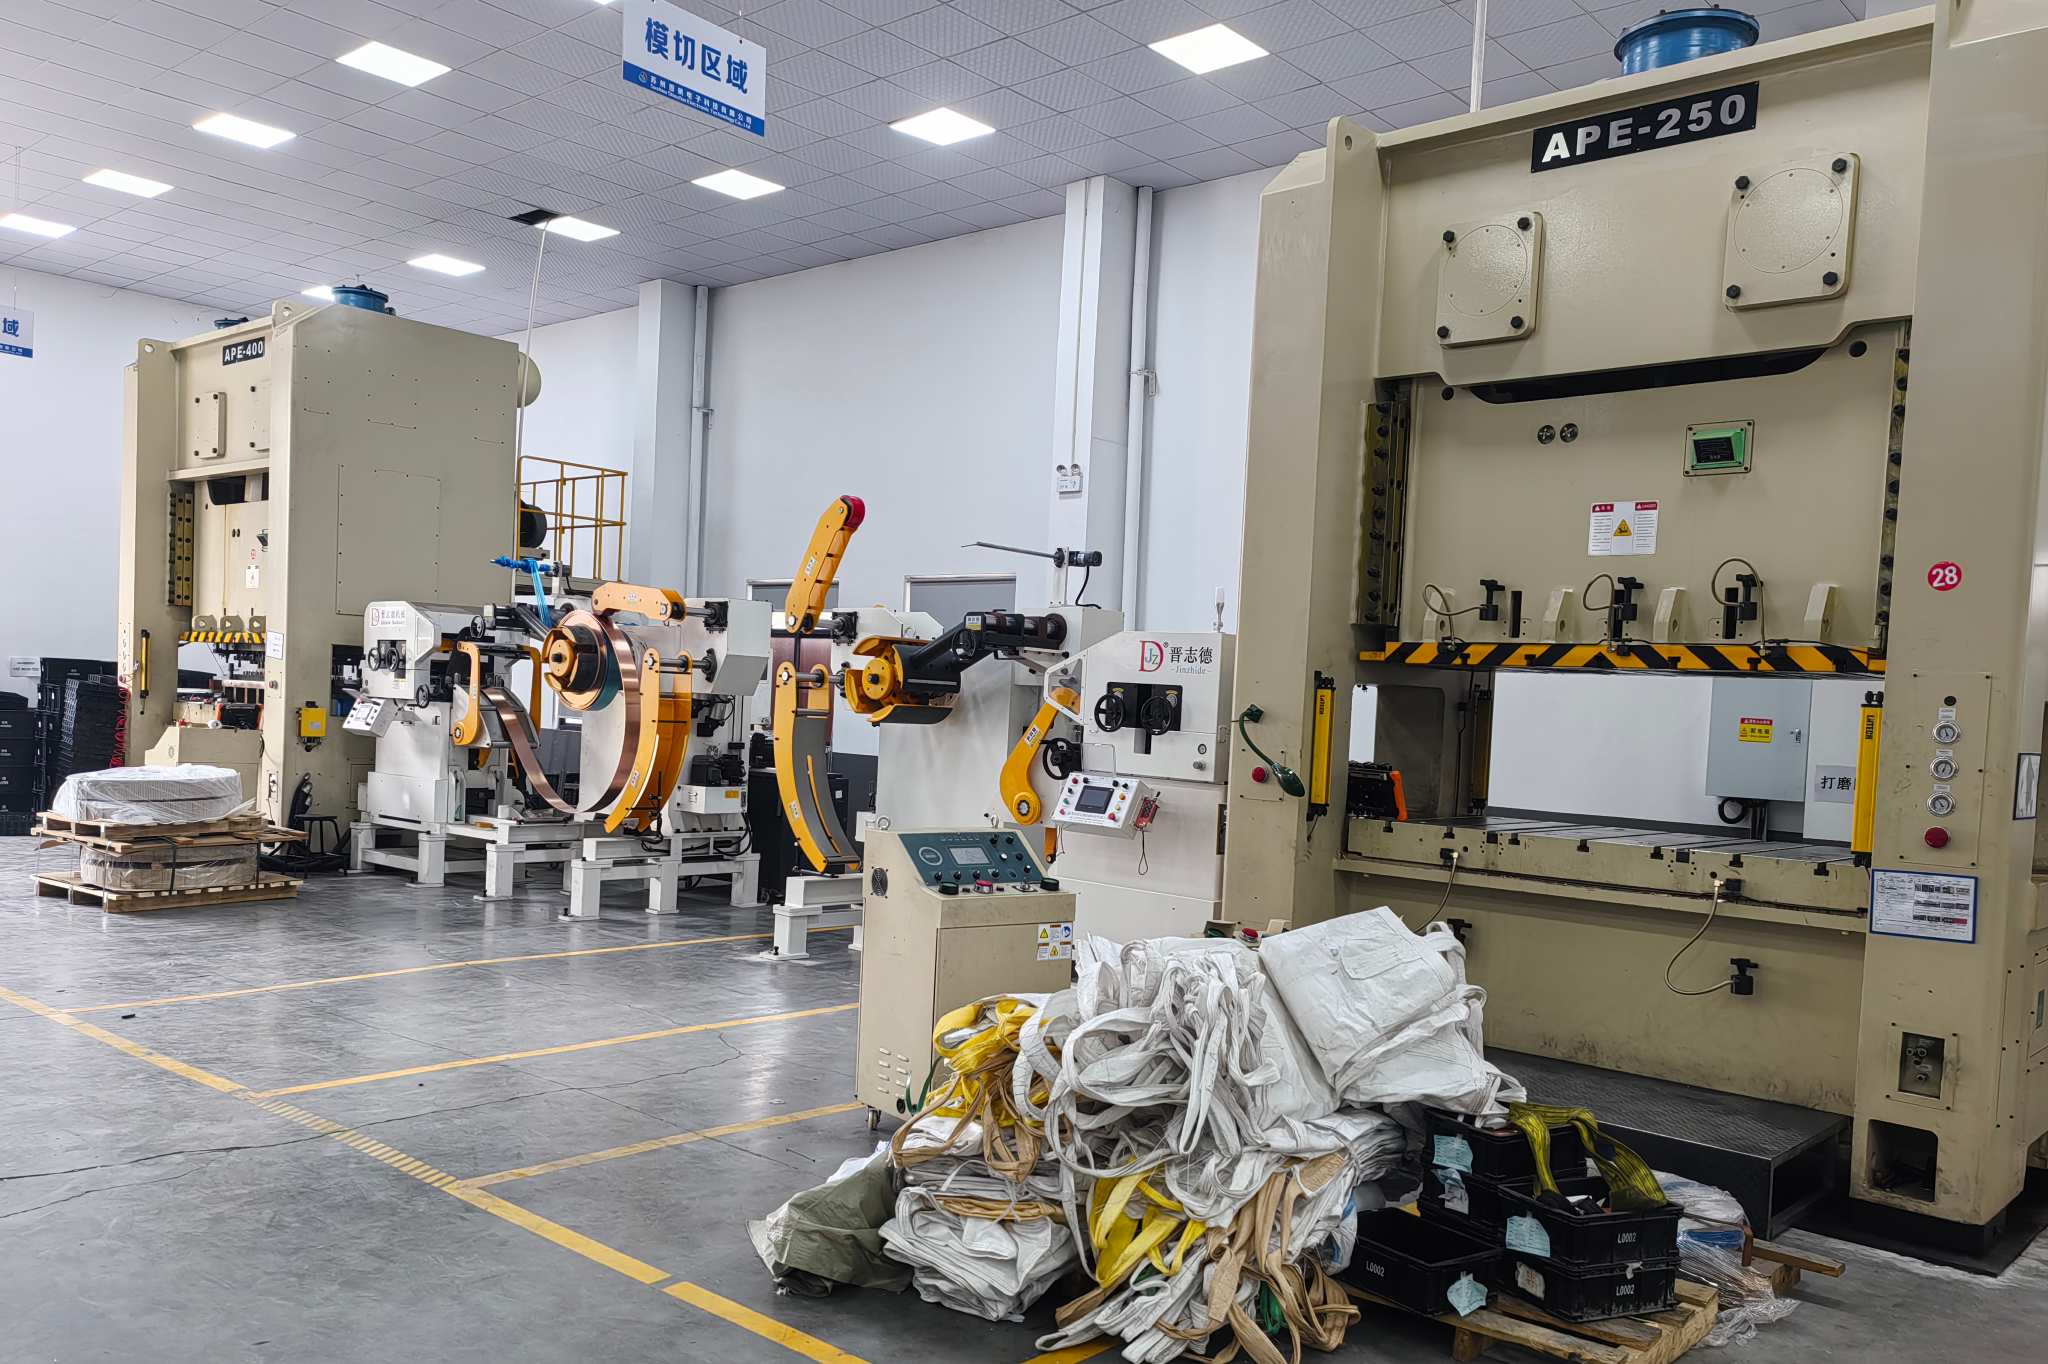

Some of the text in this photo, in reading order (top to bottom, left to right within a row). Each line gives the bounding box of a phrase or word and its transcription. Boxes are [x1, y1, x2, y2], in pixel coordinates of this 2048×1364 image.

[645, 17, 748, 94] 模切区域
[1541, 94, 1747, 163] APE-250
[3, 317, 20, 338] 域
[224, 340, 264, 362] APE-400
[1932, 565, 1958, 587] 28
[1169, 646, 1213, 664] 晋志德
[1820, 775, 1857, 791] 打磨
